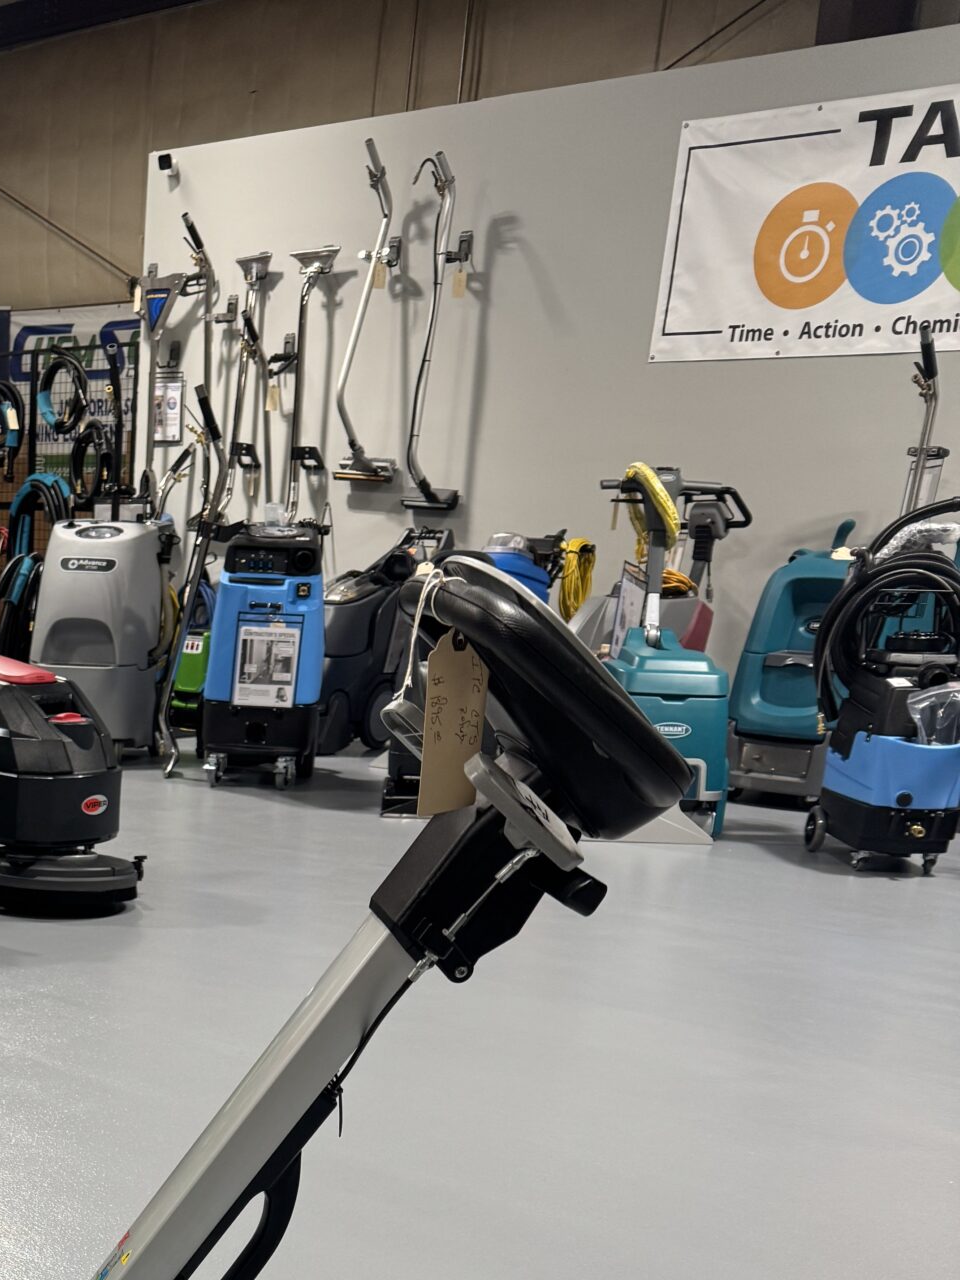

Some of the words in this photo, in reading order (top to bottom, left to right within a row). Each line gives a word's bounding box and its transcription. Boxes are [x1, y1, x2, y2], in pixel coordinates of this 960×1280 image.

[728, 324, 774, 343] Time
[798, 319, 864, 340] Action
[656, 726, 687, 735] TENNANT
[85, 799, 108, 809] VIPER
